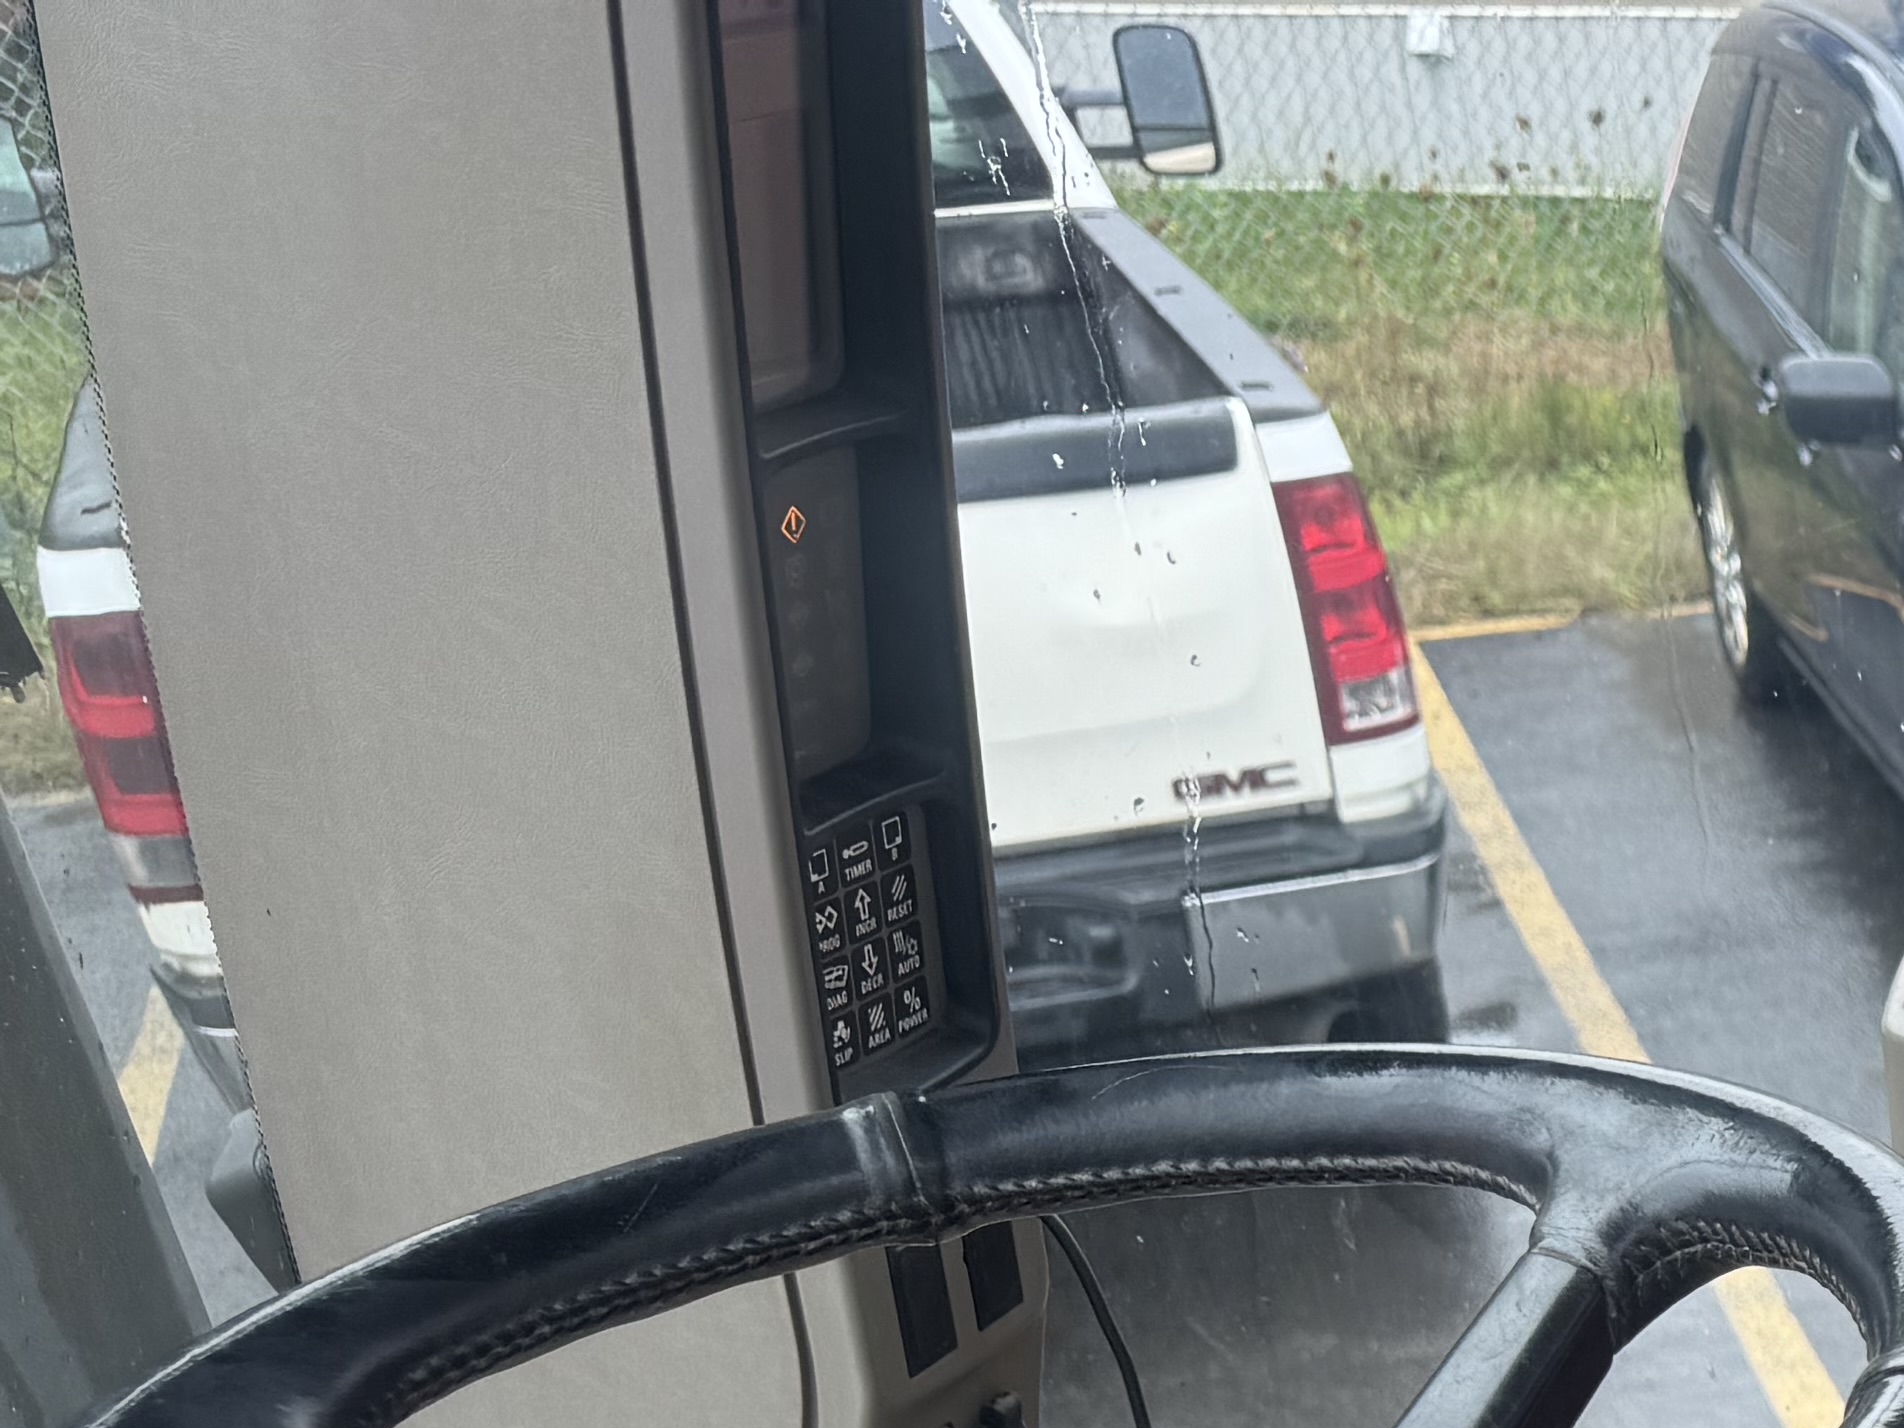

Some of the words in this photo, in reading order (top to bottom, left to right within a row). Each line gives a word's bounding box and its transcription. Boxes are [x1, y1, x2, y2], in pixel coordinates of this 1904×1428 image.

[844, 858, 873, 881] TIMER
[818, 881, 825, 894] A
[887, 899, 913, 921] RESET
[855, 916, 877, 937] INCR
[898, 954, 920, 976] AUTO
[861, 973, 885, 995] DECR
[826, 990, 849, 1011] DIAG
[898, 1009, 929, 1034] POWER
[868, 1027, 891, 1050] AREA
[834, 1046, 854, 1067] SLIP
